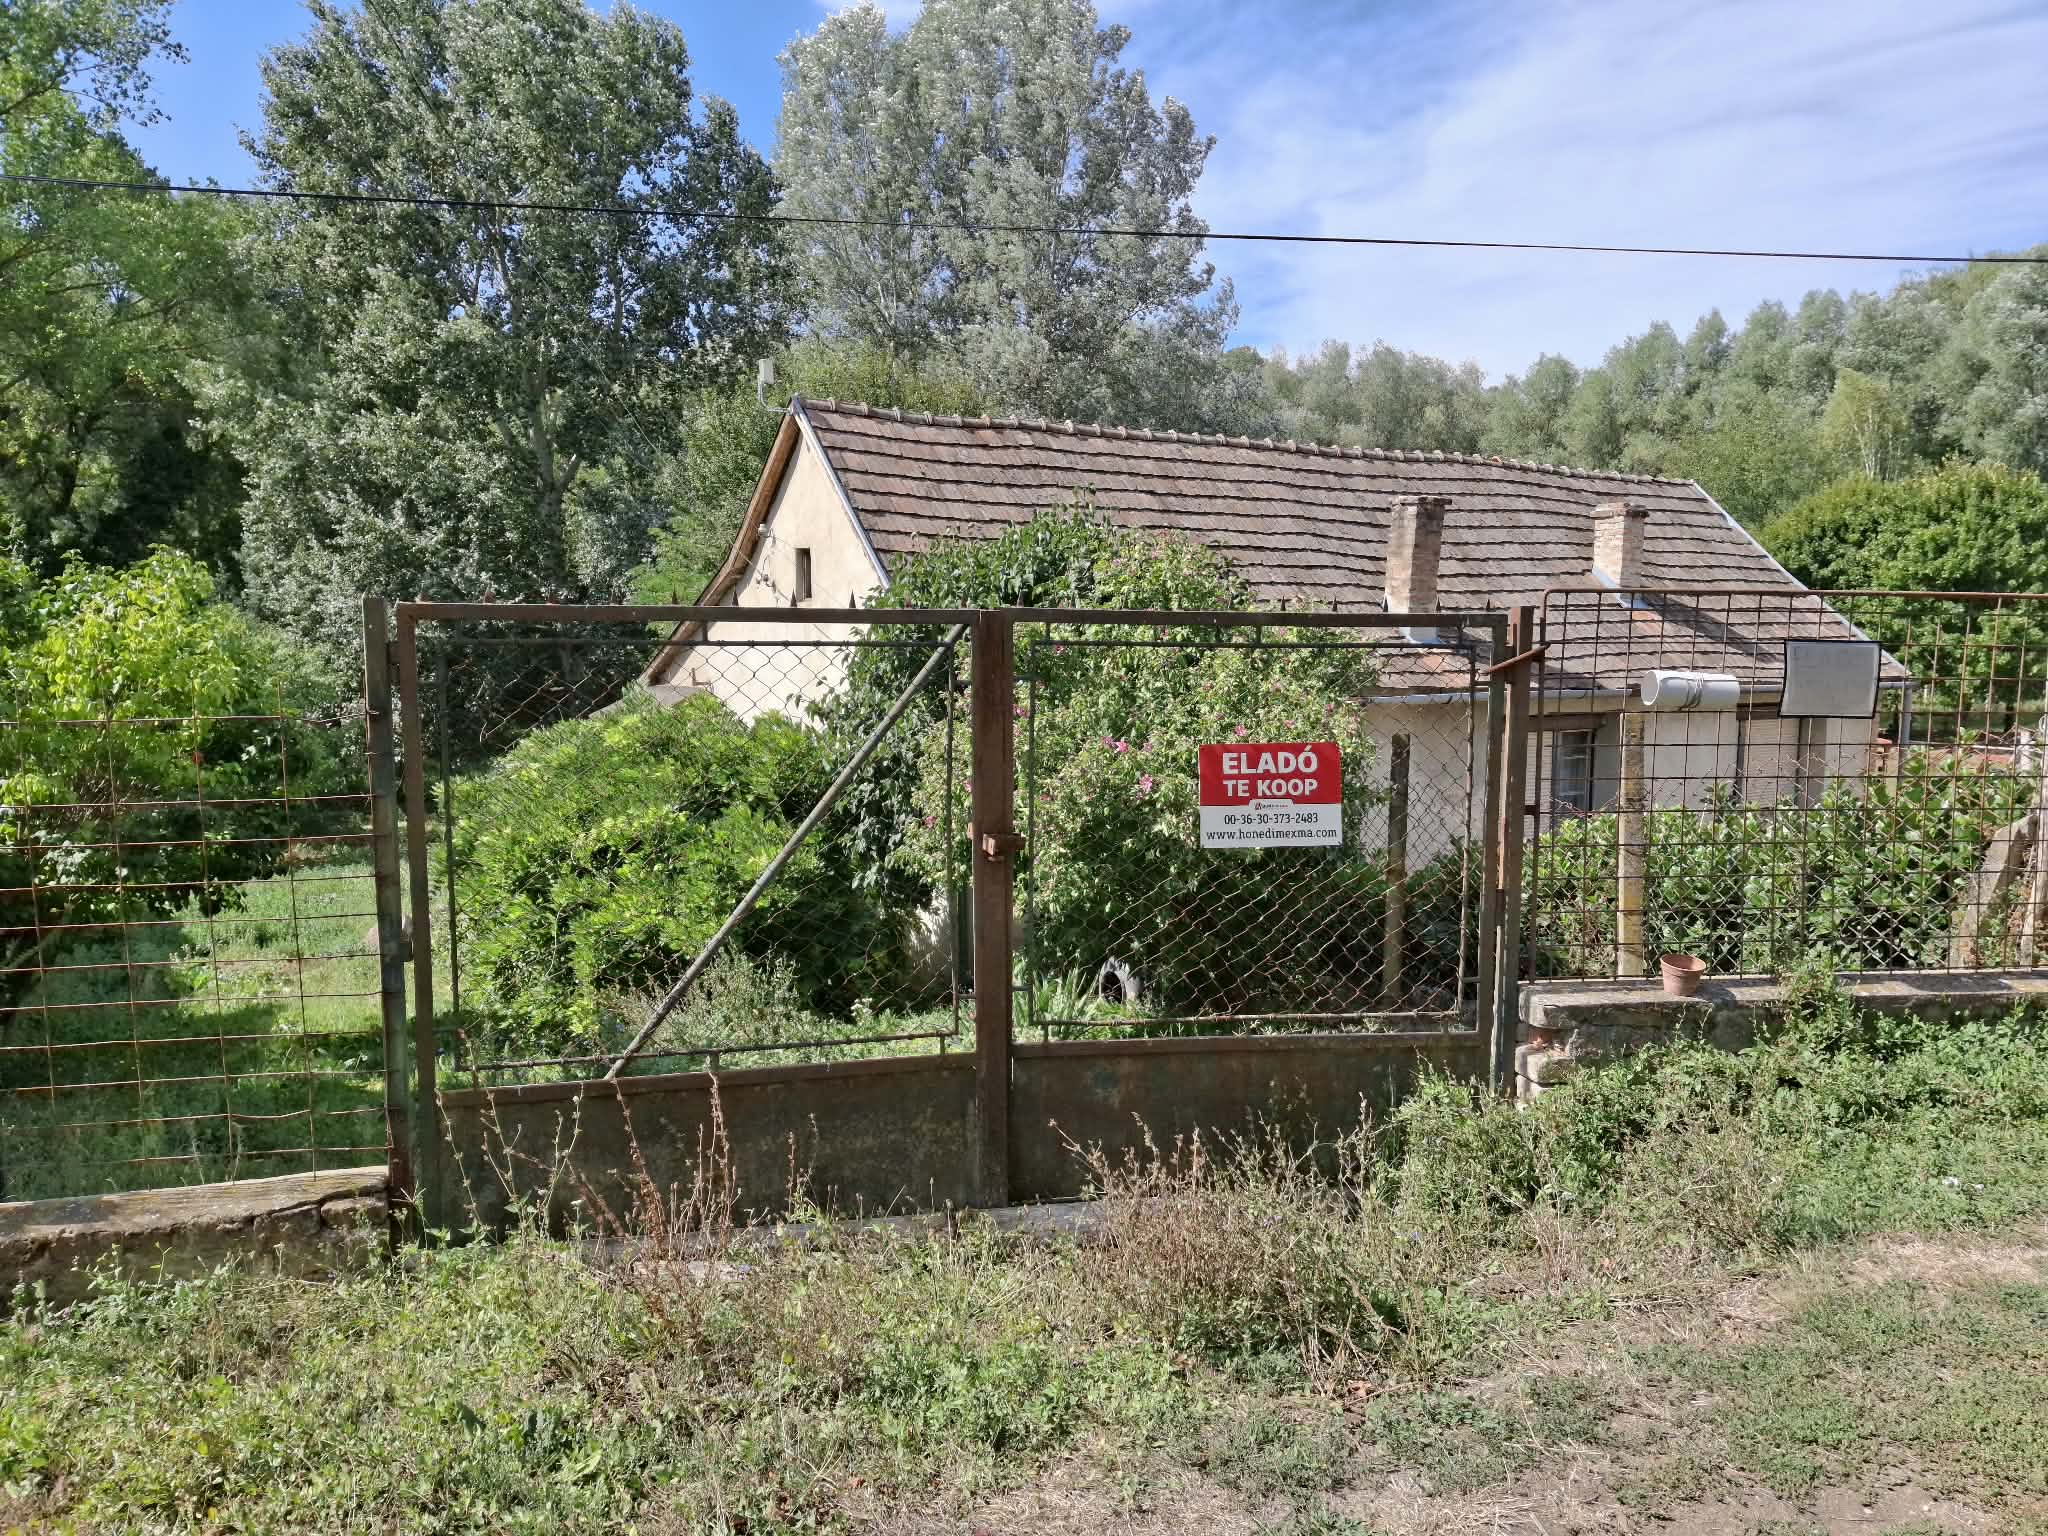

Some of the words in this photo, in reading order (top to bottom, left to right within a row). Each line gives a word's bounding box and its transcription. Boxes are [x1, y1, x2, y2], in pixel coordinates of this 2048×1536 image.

[1222, 745, 1318, 774] ELADÓ
[1222, 780, 1250, 797] TE
[1258, 778, 1318, 797] KOOP
[1224, 813, 1319, 825] 00-36-30-373-2483
[1206, 828, 1337, 840] www.honedimexma.com
